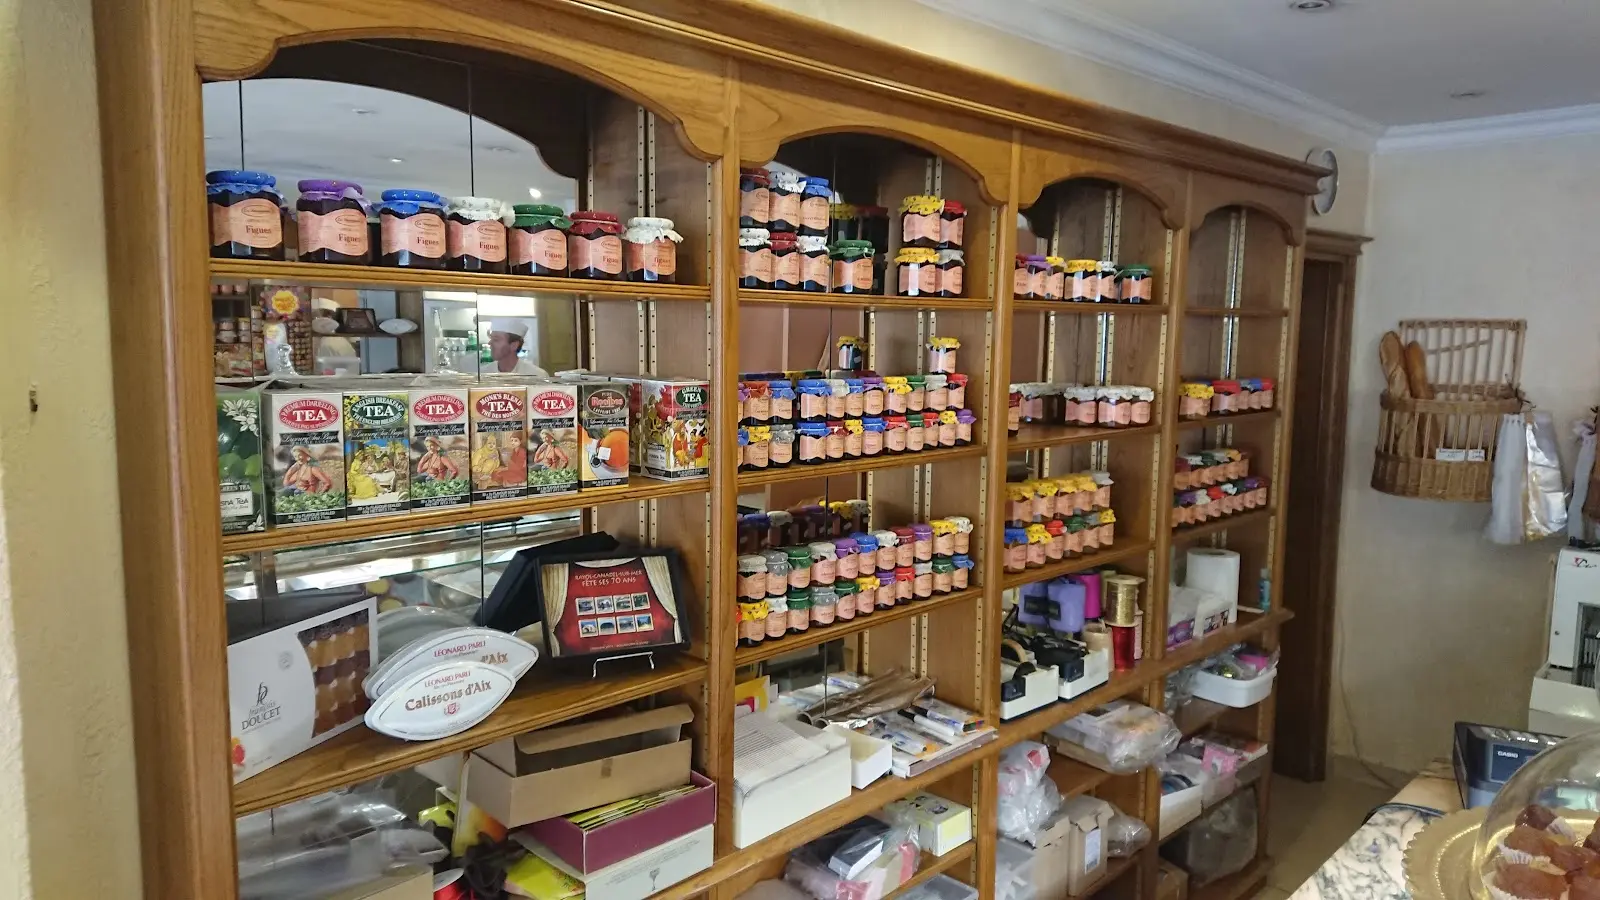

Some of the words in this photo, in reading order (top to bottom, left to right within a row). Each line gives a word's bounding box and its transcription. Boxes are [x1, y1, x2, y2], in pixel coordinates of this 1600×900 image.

[246, 225, 272, 234] Figues
[338, 233, 362, 243] Figues
[417, 236, 439, 245] Figues
[479, 241, 500, 250] Figues
[681, 386, 702, 394] GREEN
[479, 394, 502, 406] MONK'S
[503, 394, 523, 406] BLEND
[591, 396, 624, 406] Rooibos
[683, 393, 702, 403] TEA
[280, 401, 306, 417] PREMIUM
[352, 398, 376, 412] ENGLISH
[376, 397, 404, 411] BREAKFAST
[426, 404, 455, 415] TEA
[488, 401, 514, 412] TEA
[541, 399, 567, 410] TEA
[292, 410, 327, 422] TEA
[363, 405, 394, 417] TEA
[283, 434, 310, 444] Luxury
[321, 432, 337, 442] Bags
[598, 578, 610, 586] SES
[405, 689, 463, 712] Calissons
[465, 680, 492, 696] d'Aix
[242, 706, 281, 730] DOUCET
[1497, 750, 1519, 759] CASIO
